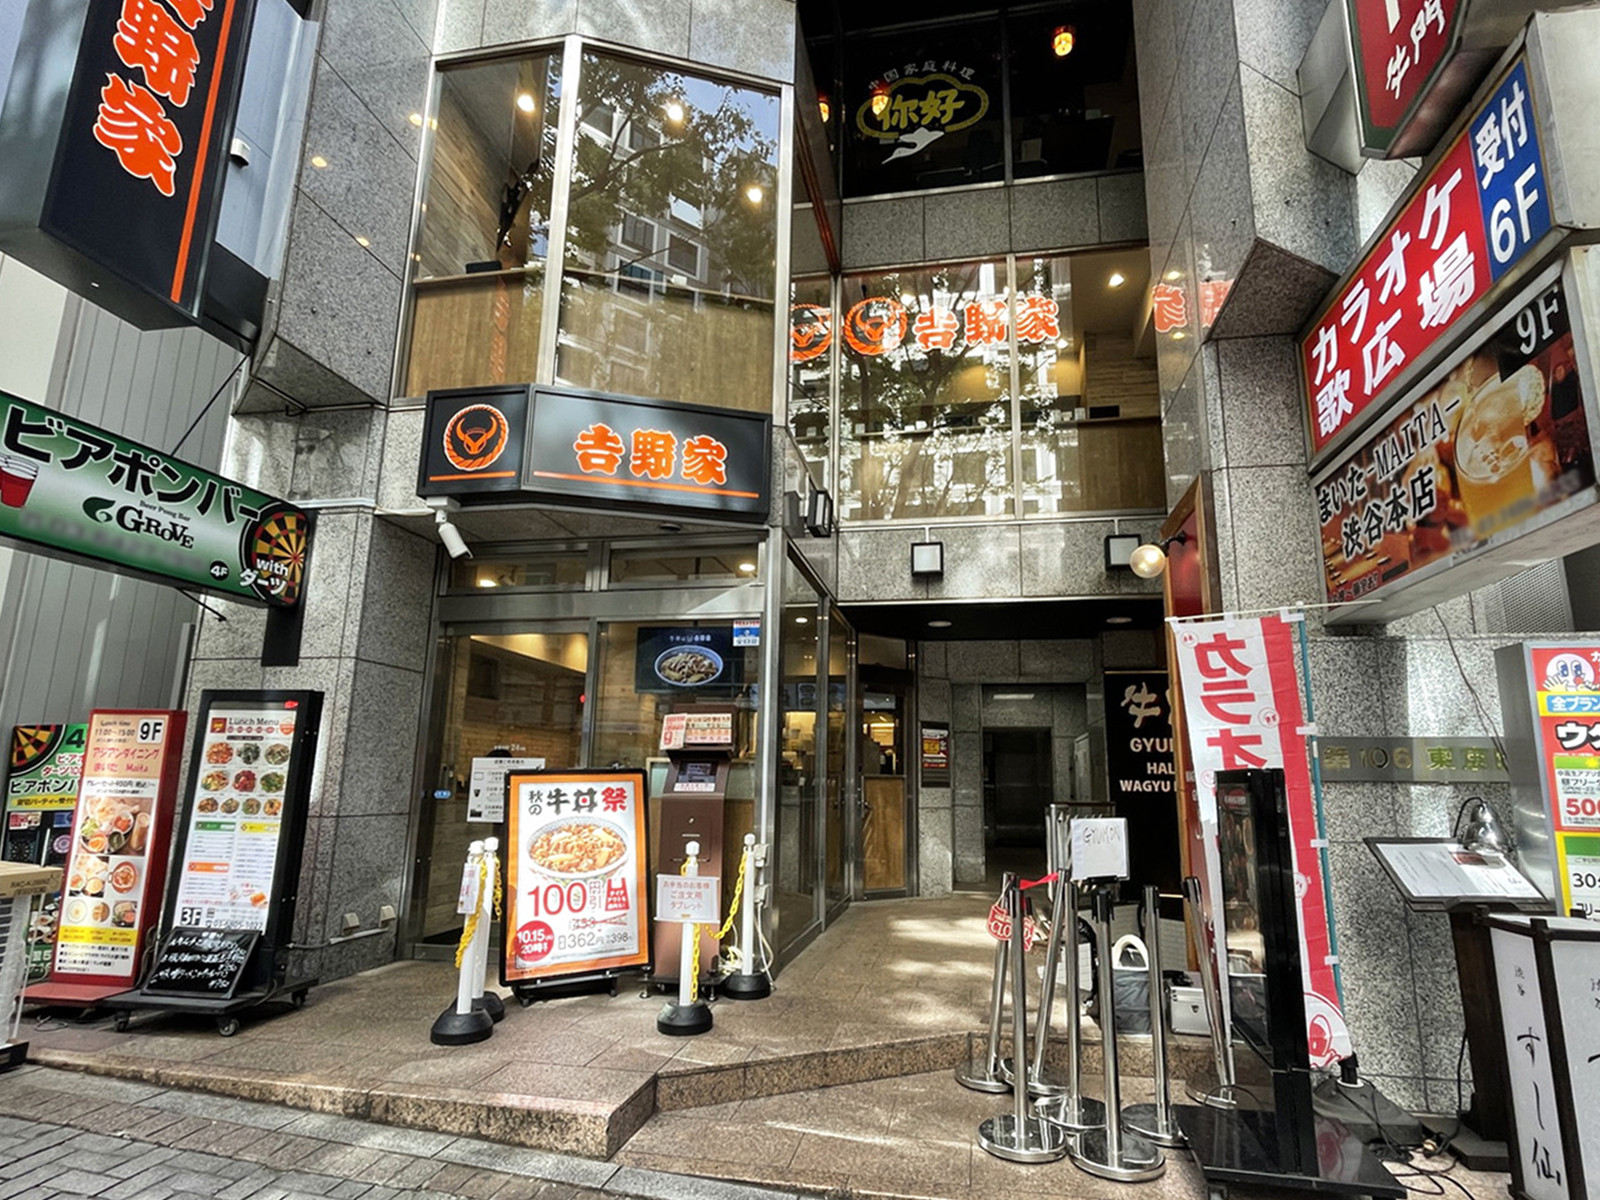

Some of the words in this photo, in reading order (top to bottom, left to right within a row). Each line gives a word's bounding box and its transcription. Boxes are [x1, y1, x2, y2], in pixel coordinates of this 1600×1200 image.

[1475, 80, 1529, 190] 受付
[1490, 163, 1539, 264] 6F
[1312, 168, 1463, 385] カラオケ
[913, 296, 1061, 352] 吉野家
[1315, 231, 1476, 438] 歌広場
[1516, 288, 1559, 355] 9F
[3, 404, 262, 525] ビアポンバー
[573, 422, 728, 485] 吉野家
[1342, 466, 1436, 561] 渋谷本店
[210, 565, 229, 577] 4F
[239, 568, 287, 595] ダーツ
[256, 558, 289, 577] with
[140, 722, 163, 741] 9F
[528, 790, 543, 816] 秋の
[546, 787, 628, 815] 牛丼祭
[1120, 780, 1171, 792] WAGYU
[1566, 798, 1600, 816] 50
[181, 907, 202, 926] 3F
